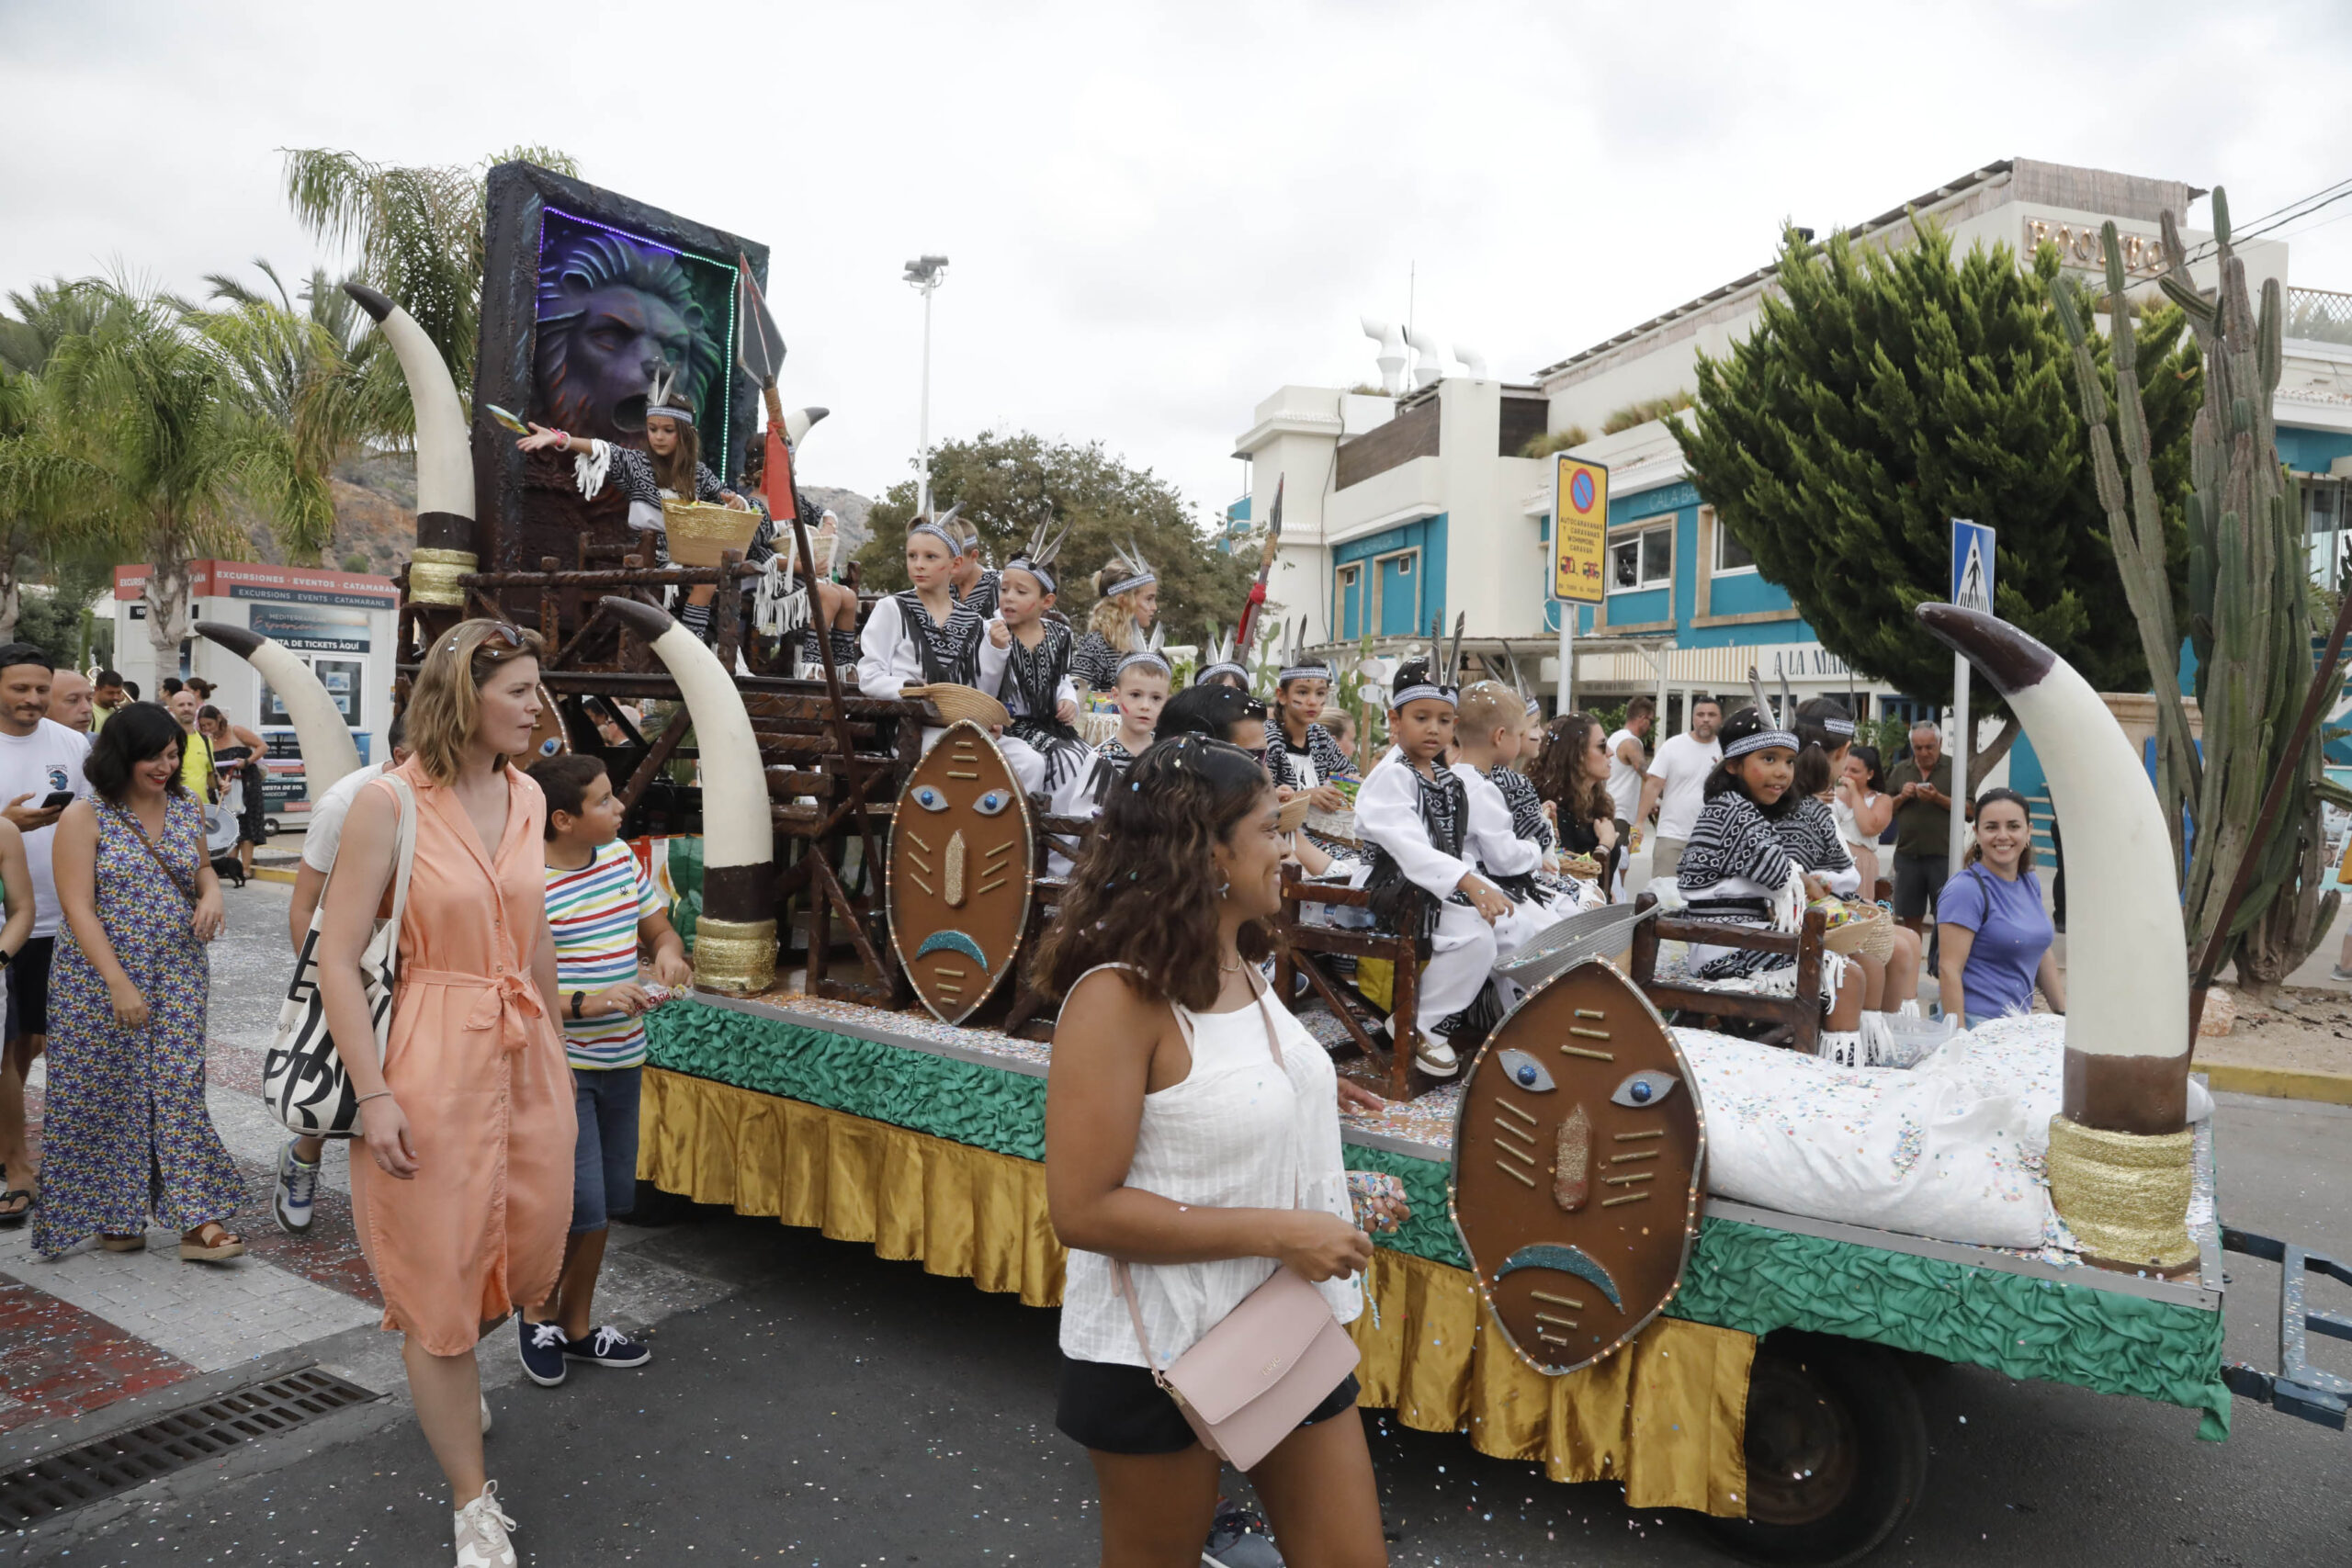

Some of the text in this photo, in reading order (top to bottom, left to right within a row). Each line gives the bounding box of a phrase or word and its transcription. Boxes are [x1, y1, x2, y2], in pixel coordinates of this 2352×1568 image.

[1681, 485, 1698, 504] BA
[1560, 516, 1603, 531] AUTOCARAVANAS
[1570, 526, 1600, 539] CARAVANAS
[1569, 545, 1593, 554] CARAVAN
[216, 570, 401, 593] EXCURSIONES EVENTOS CATAMARANE
[239, 589, 386, 607] EXCURSIONS EVENTS CATAMARANS
[304, 640, 338, 649] TICKETS
[1774, 651, 1782, 675] A
[1789, 650, 1804, 675] LA
